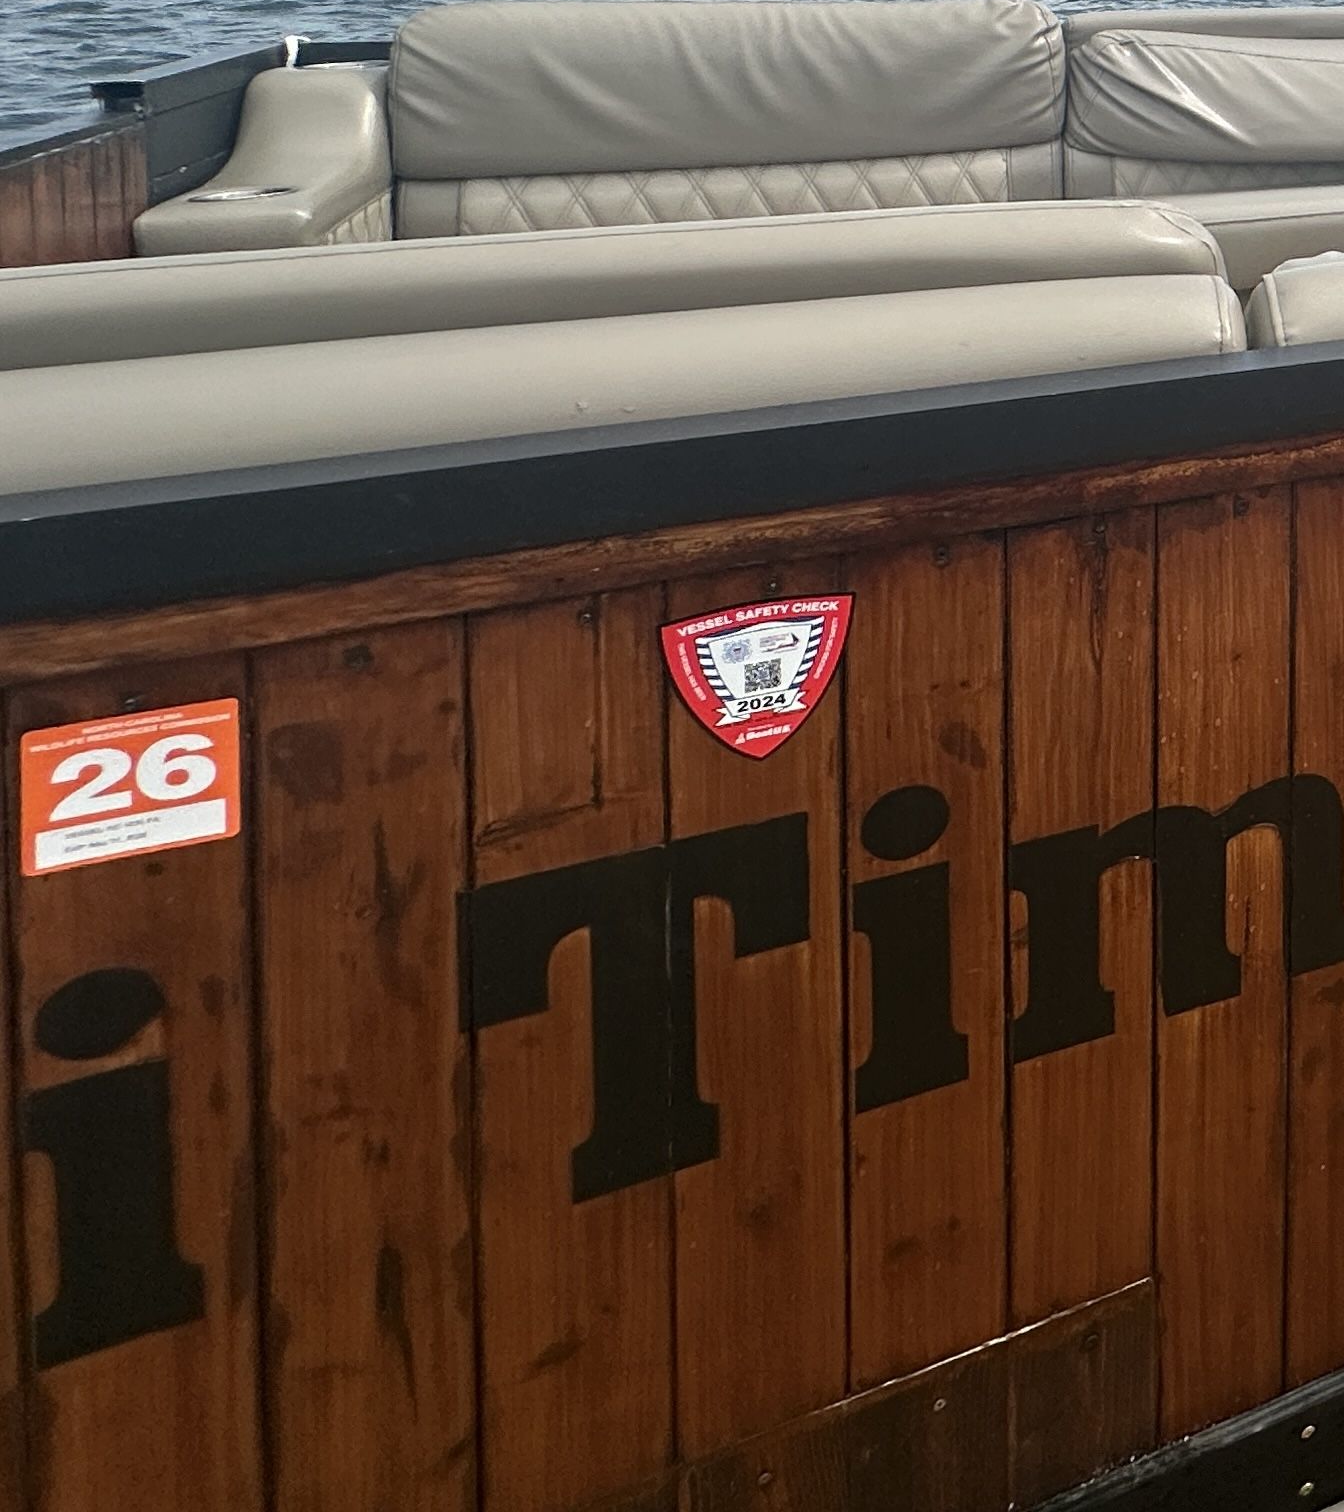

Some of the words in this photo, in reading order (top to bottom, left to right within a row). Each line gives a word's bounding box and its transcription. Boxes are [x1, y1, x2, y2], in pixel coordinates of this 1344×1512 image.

[677, 615, 733, 637] VESSEL
[735, 602, 789, 622] SAFETY
[792, 600, 840, 614] CHECK
[737, 693, 786, 713] 2024
[49, 733, 216, 822] 26
